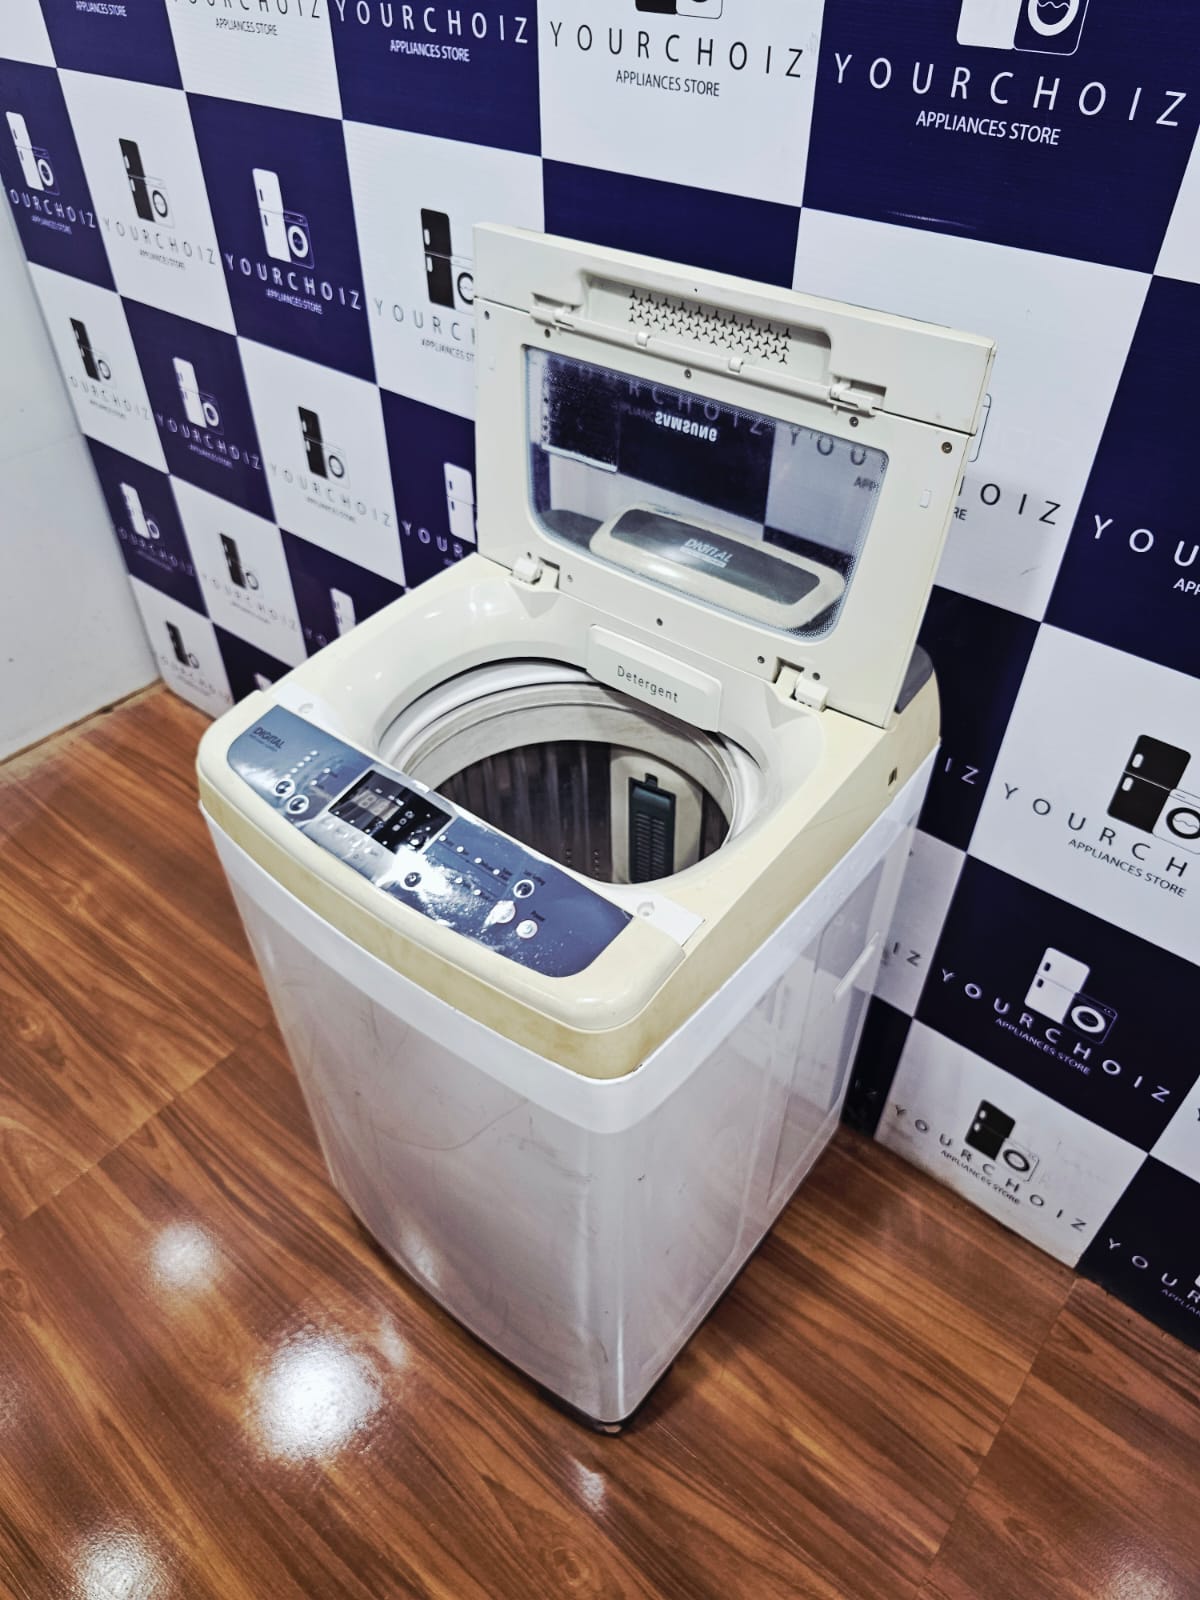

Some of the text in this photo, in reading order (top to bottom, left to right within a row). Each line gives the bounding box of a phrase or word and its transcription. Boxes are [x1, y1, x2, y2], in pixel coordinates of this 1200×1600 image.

[215, 18, 278, 36] APPLIANCES STORE
[335, 0, 529, 44] YOURCHOIZ
[390, 39, 470, 62] APPLIANCES STORE
[550, 20, 803, 78] YOURCHOIZ
[615, 69, 720, 97] APPLIANCES STORE
[834, 53, 1187, 127] YOURCHOIZ
[916, 110, 1061, 146] APPLIANCES STORE
[104, 217, 217, 265] YOURCHOIZ
[224, 252, 361, 310] YOURCHOIZ
[684, 538, 733, 562] DIGITAL
[617, 665, 678, 703] Detergent
[253, 726, 286, 749] DIGITAL
[1004, 782, 1188, 877] YOURCH
[1068, 838, 1186, 897] APPLIANCES STORE
[941, 968, 1170, 1103] YOURCHOIZ
[995, 1017, 1092, 1076] APPLIANCES STORE
[894, 1104, 1087, 1231] YOURCHOIZ
[940, 1149, 992, 1186] APPLIANCES
